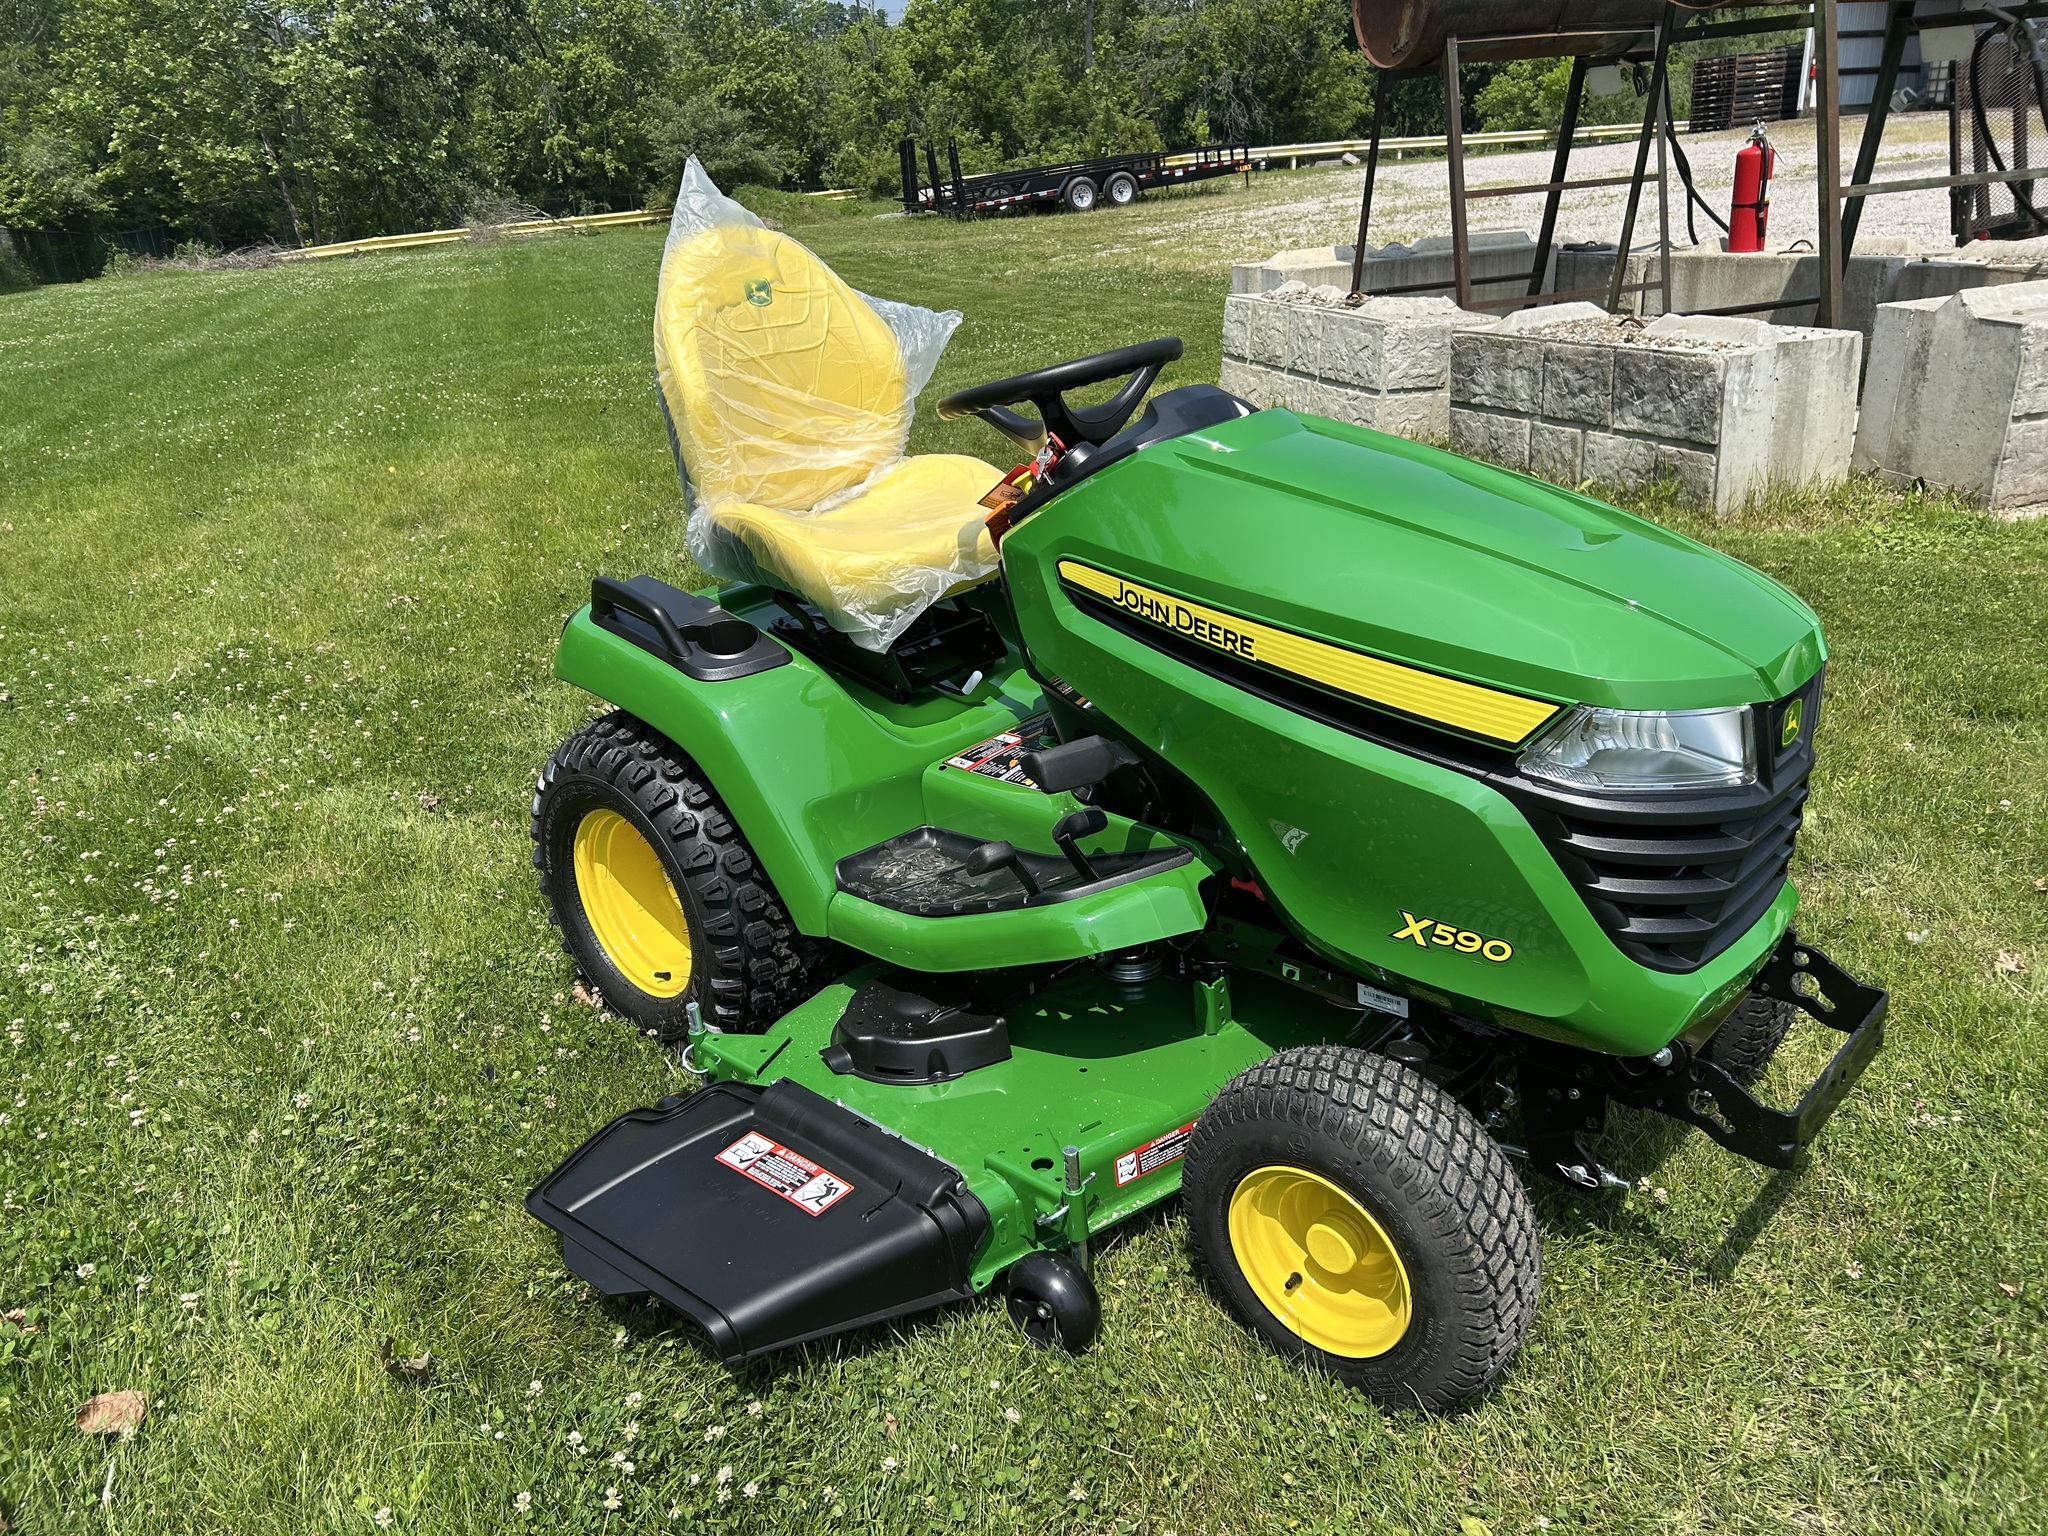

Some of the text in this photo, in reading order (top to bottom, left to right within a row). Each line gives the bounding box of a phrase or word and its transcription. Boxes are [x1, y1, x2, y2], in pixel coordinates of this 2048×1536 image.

[1175, 605, 1256, 660] DEERE
[1388, 908, 1514, 963] X590
[1155, 1129, 1180, 1145] DANGER
[784, 1152, 819, 1173] DANGER
